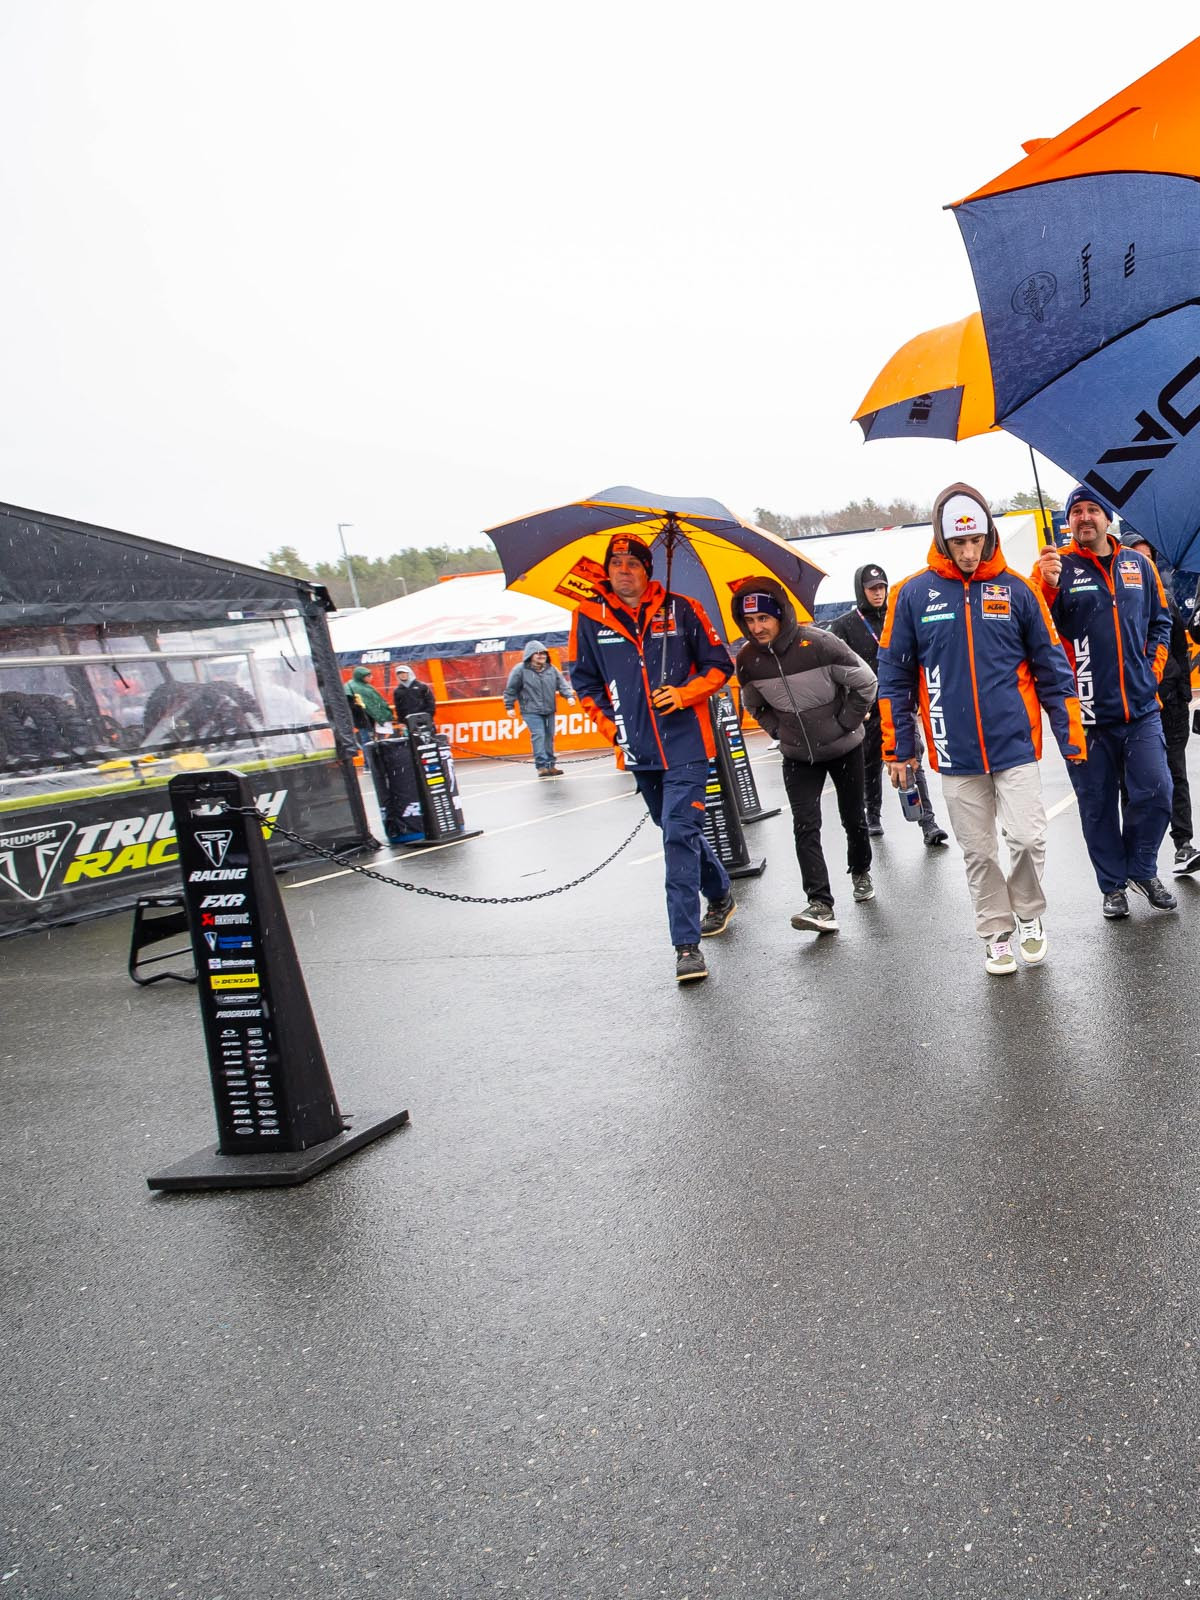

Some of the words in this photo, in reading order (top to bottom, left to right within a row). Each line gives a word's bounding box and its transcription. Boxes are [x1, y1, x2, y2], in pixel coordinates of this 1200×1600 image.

[926, 664, 952, 767] RACING
[437, 719, 527, 744] ACTORY
[189, 868, 248, 882] RACING
[200, 894, 246, 908] FXR
